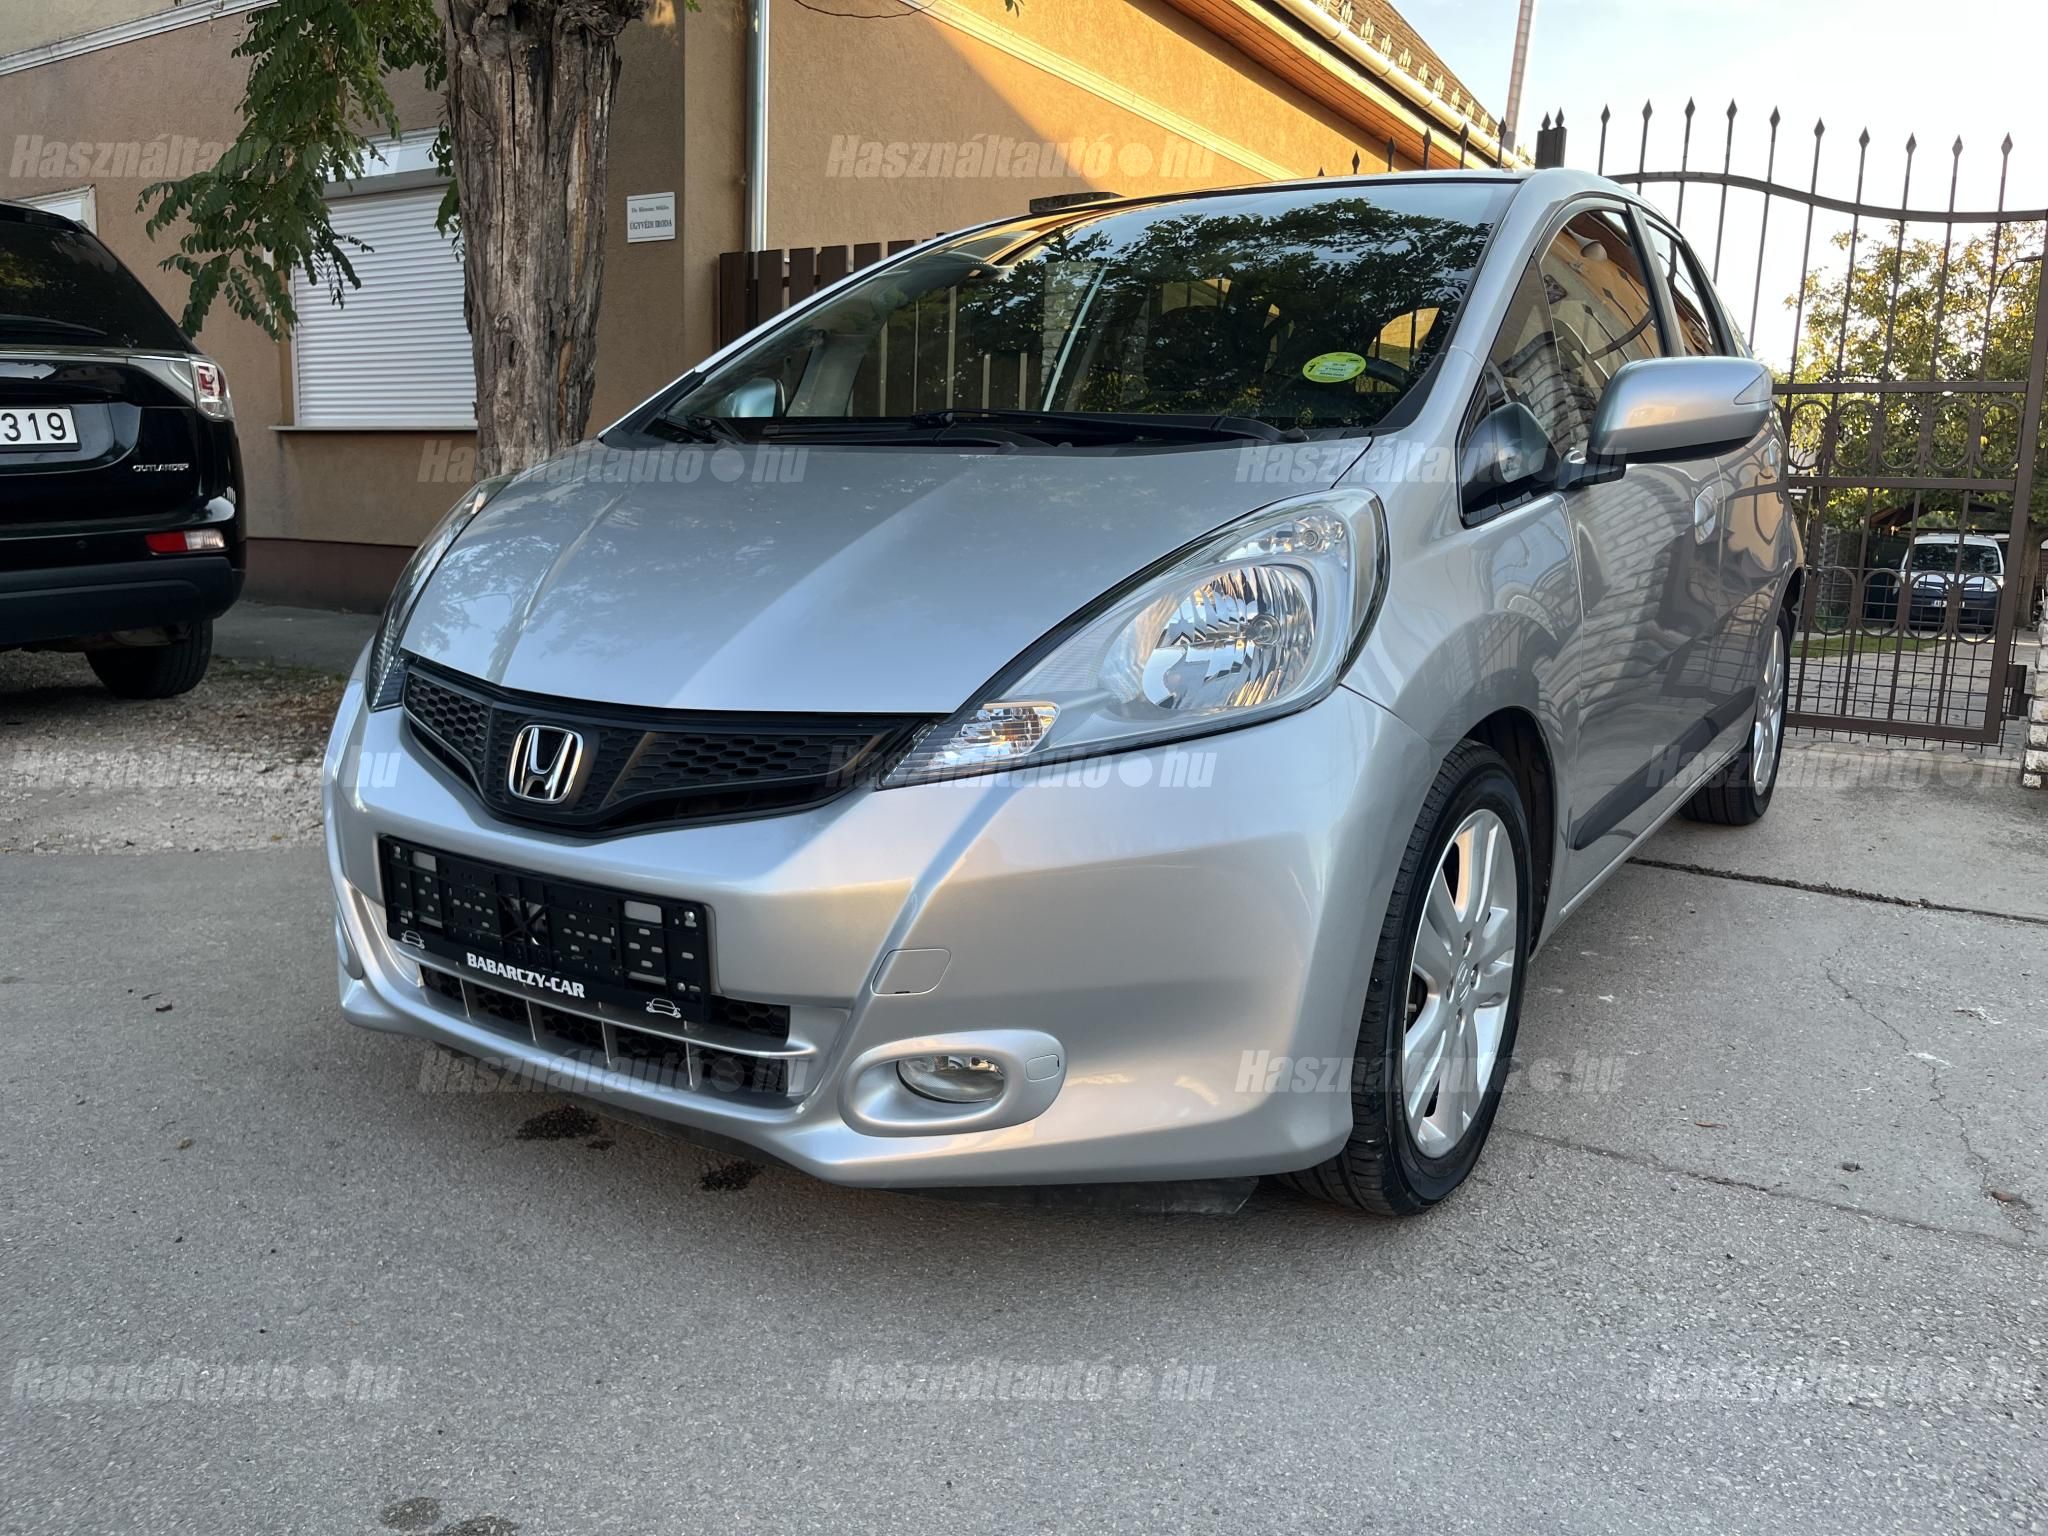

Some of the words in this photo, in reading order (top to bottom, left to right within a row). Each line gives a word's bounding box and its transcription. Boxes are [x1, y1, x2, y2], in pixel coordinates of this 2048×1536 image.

[1, 412, 67, 442] 319
[132, 463, 189, 472] OUTLANDER
[466, 951, 586, 998] BABARCZY-CAR
